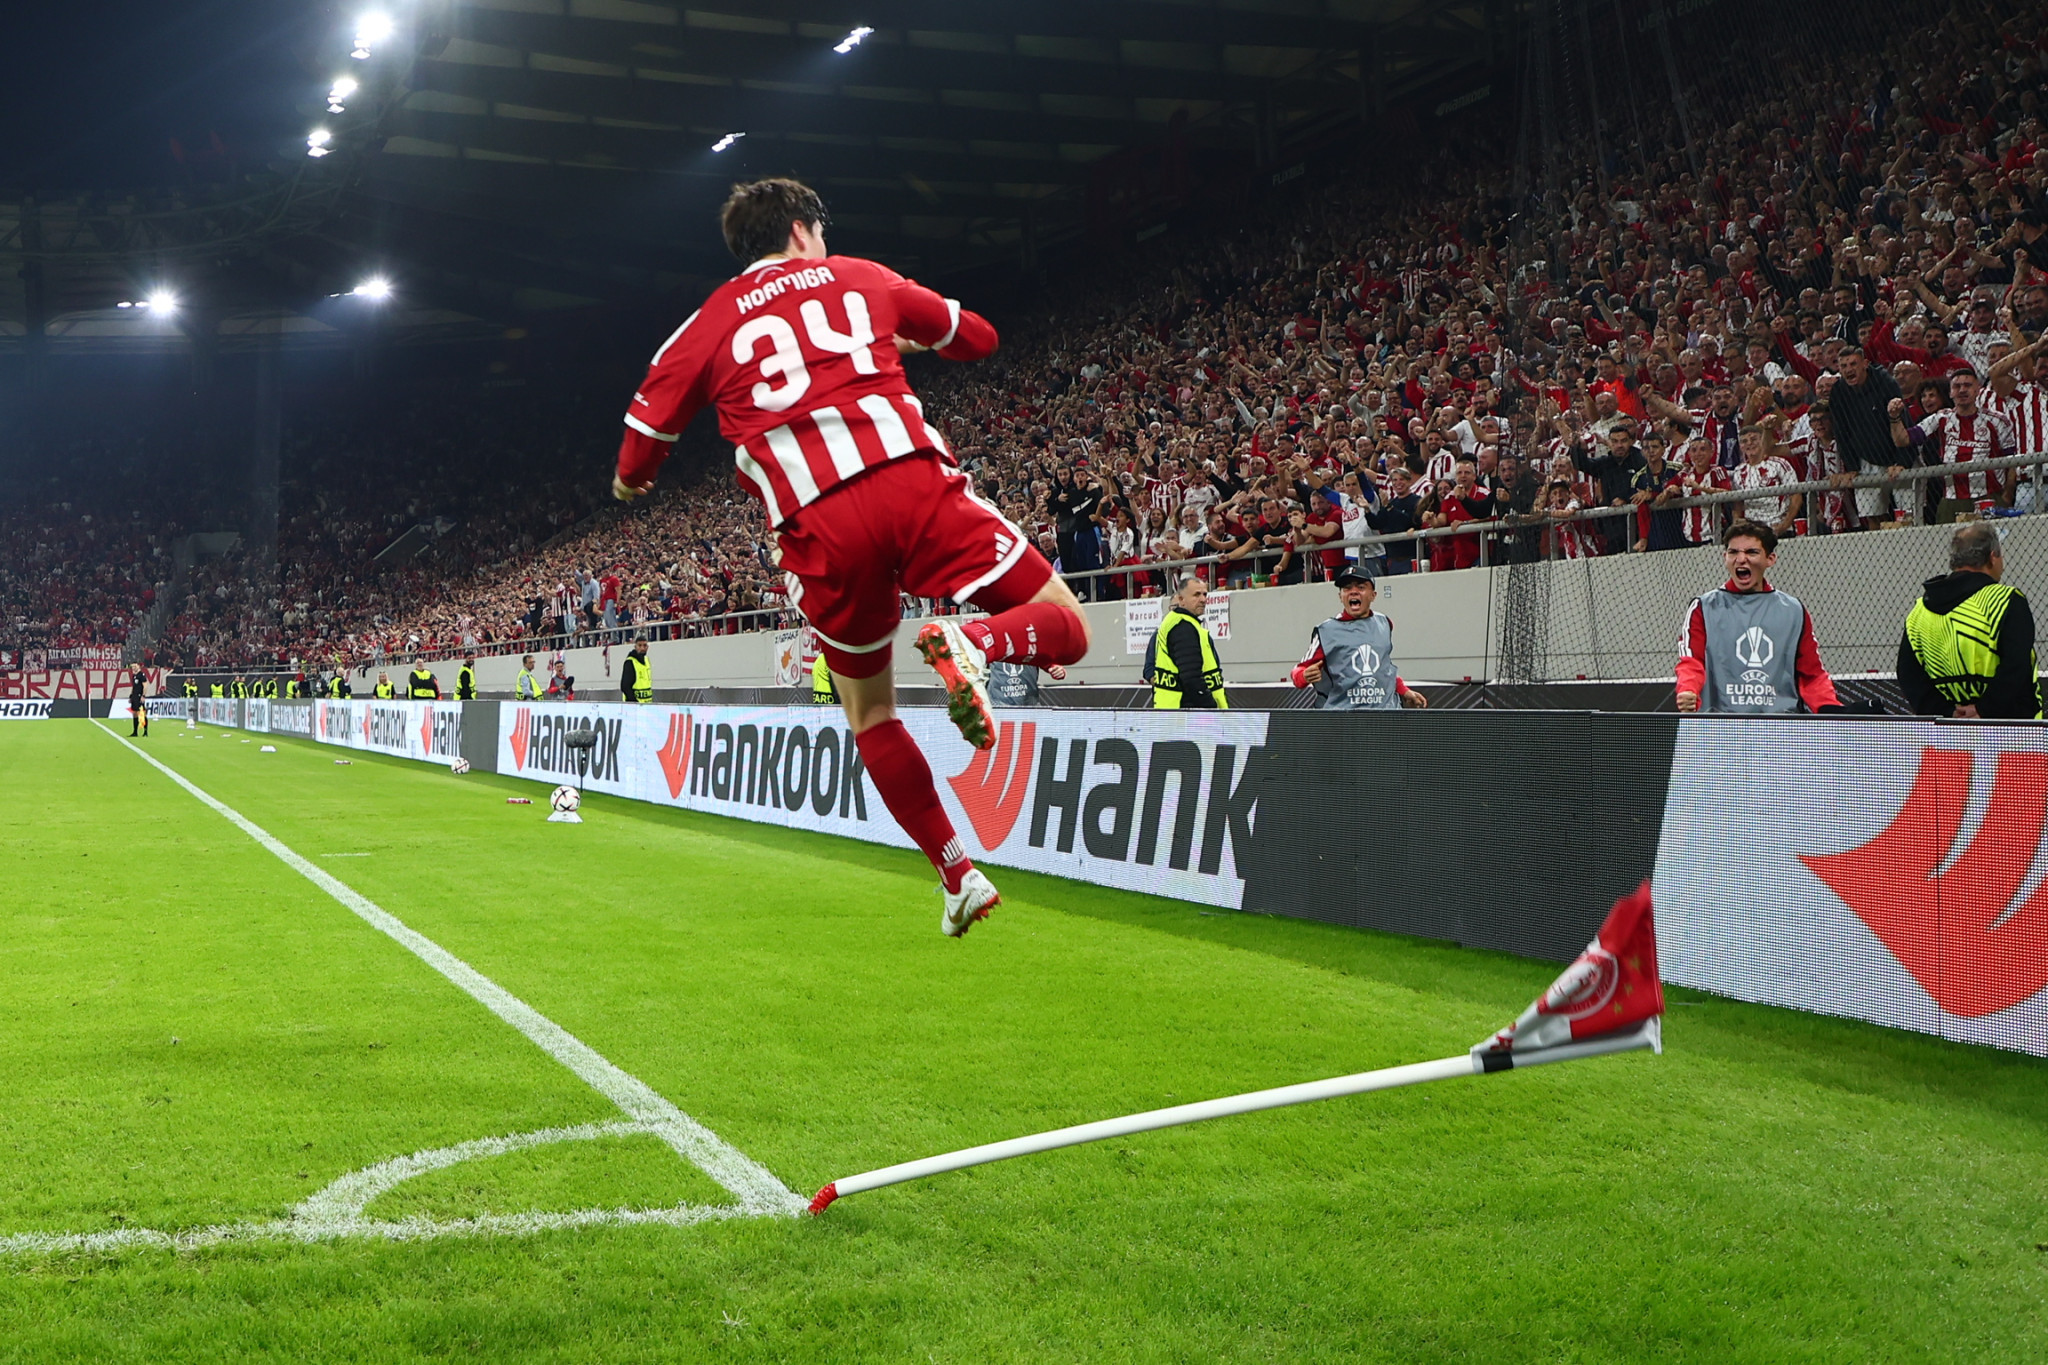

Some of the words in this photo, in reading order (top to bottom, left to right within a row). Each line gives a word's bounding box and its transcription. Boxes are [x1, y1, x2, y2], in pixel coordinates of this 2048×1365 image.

[735, 266, 836, 315] HORMIGA
[731, 291, 880, 412] 34
[1217, 622, 1229, 637] 27
[82, 647, 121, 660] AMFISSA
[1742, 671, 1767, 682] UEFA
[1000, 684, 1028, 692] EUROPA
[1347, 688, 1386, 697] EUROPA
[1726, 684, 1776, 696] EUROPA
[1350, 696, 1383, 704] LEAGUE
[1731, 695, 1774, 706] LEAGUE
